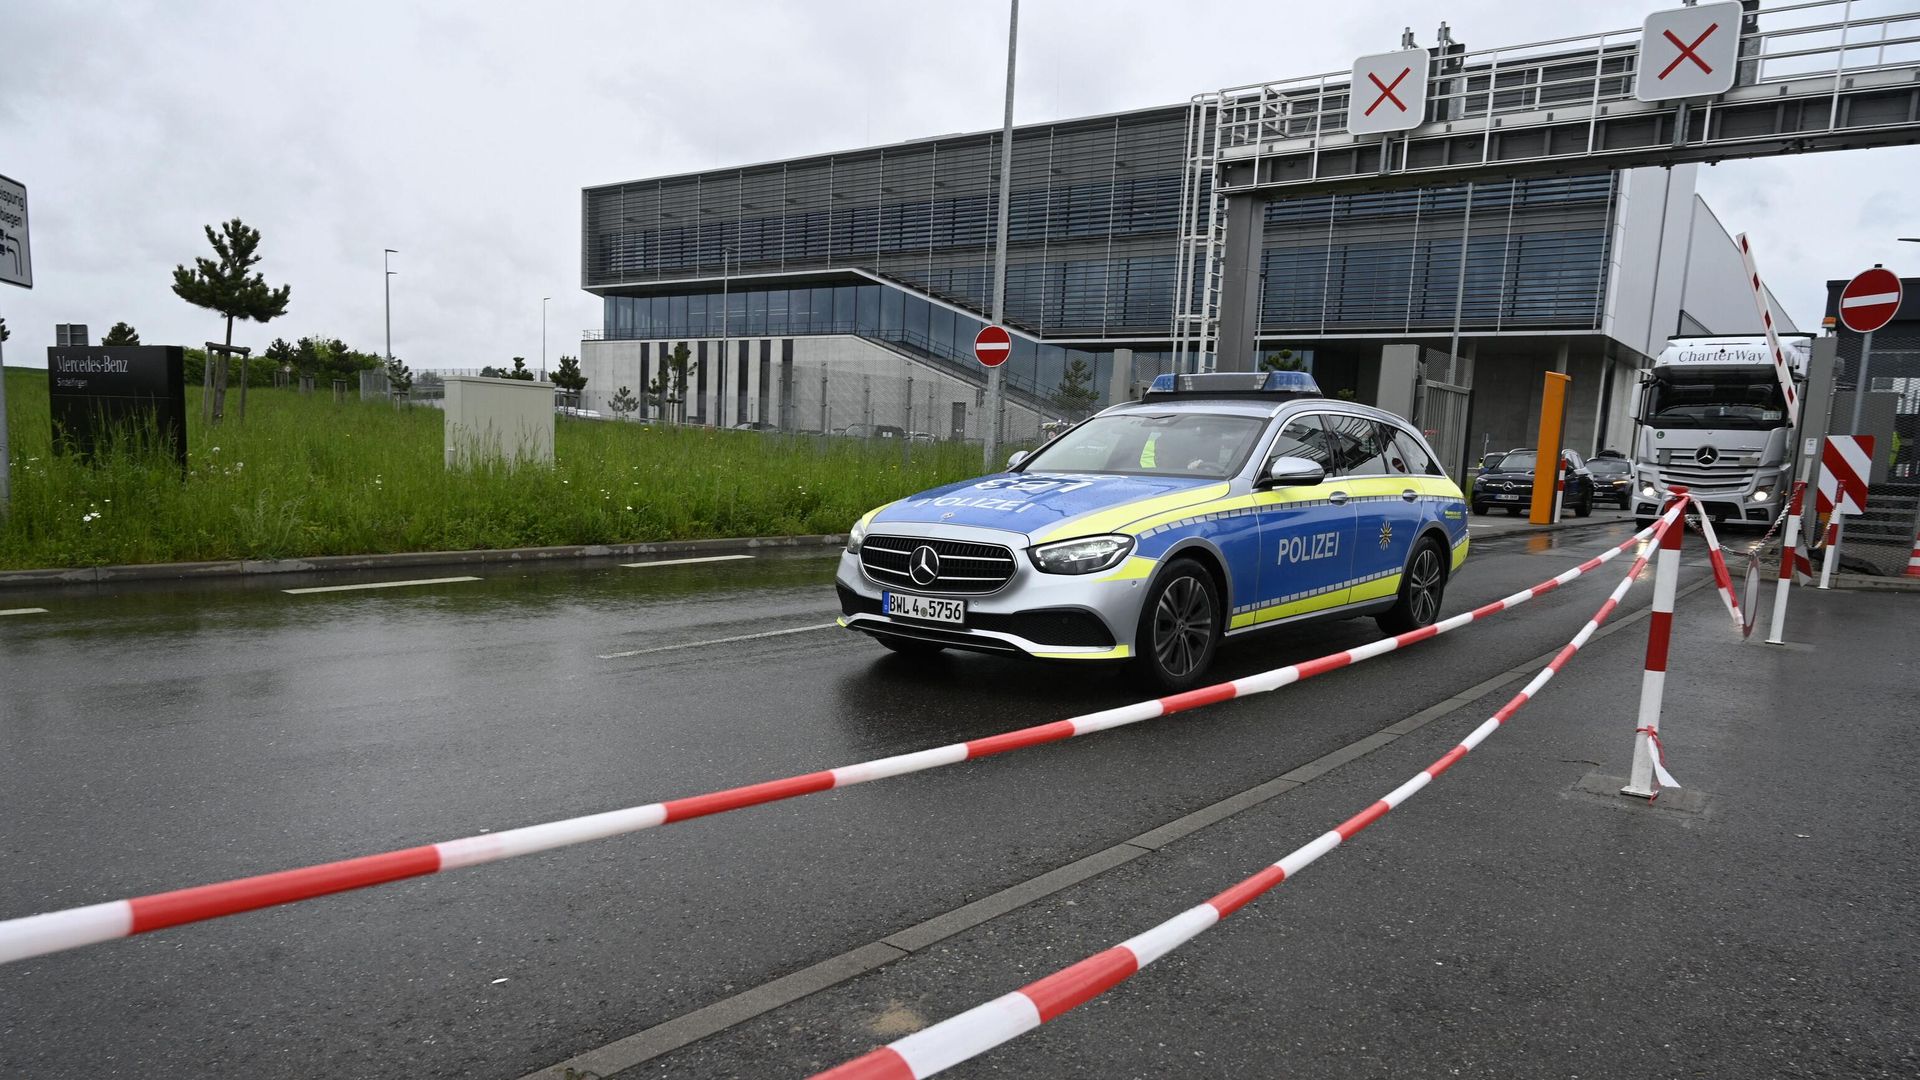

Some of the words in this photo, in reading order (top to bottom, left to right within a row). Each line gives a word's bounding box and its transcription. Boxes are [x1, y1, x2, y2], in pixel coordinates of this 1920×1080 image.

[57, 355, 128, 373] Mercedes-Benz
[1678, 350, 1764, 365] CharterWay
[1277, 532, 1340, 566] POLIZEI
[913, 599, 919, 615] 4
[929, 600, 961, 620] 5756
